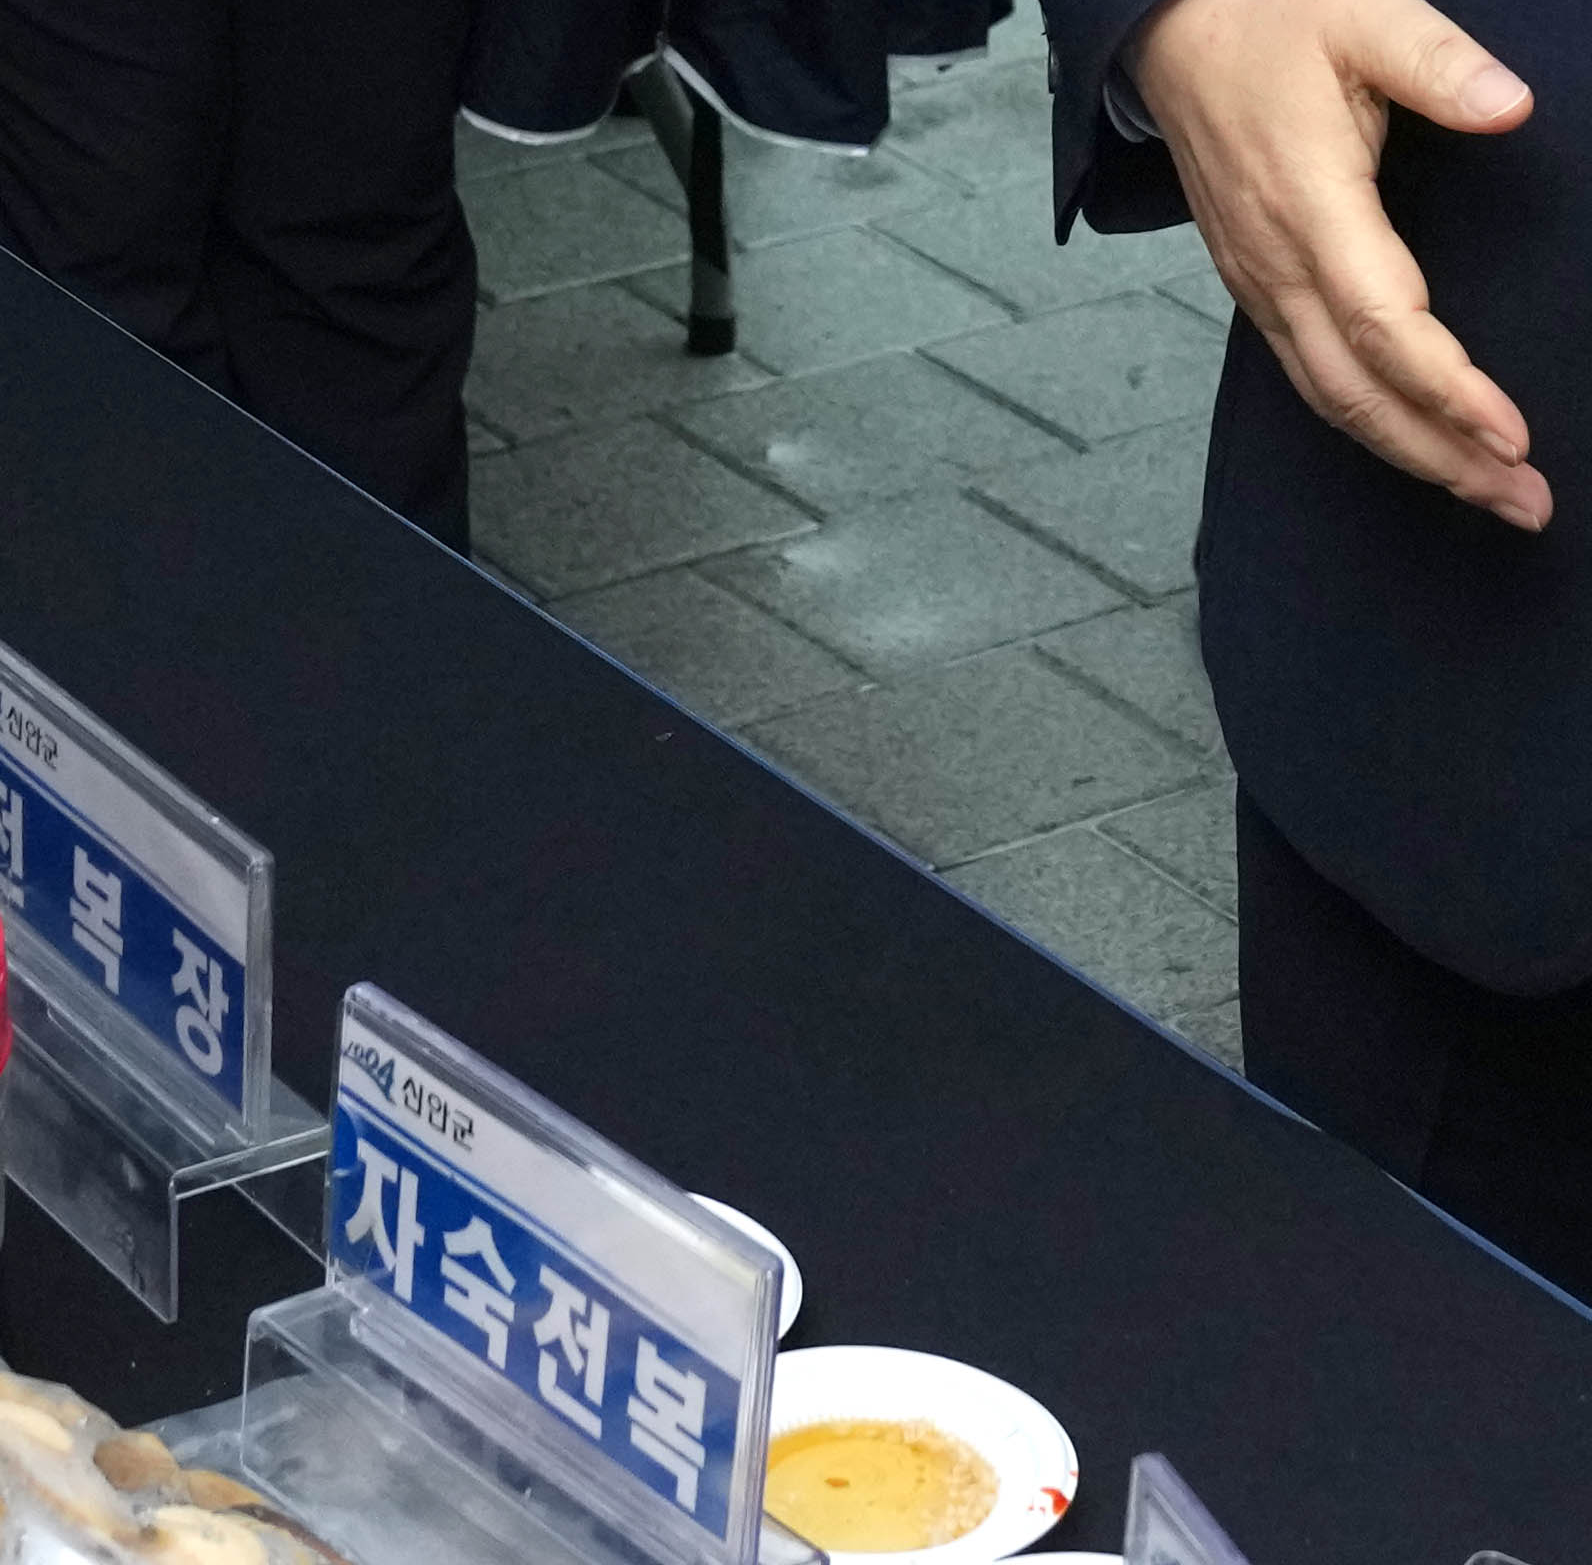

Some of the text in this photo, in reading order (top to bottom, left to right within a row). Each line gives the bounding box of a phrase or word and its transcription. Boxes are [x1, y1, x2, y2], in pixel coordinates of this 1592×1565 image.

[5, 706, 59, 771] 신안군
[400, 1073, 476, 1154] 신안군
[344, 1132, 710, 1516] 자숙전복
